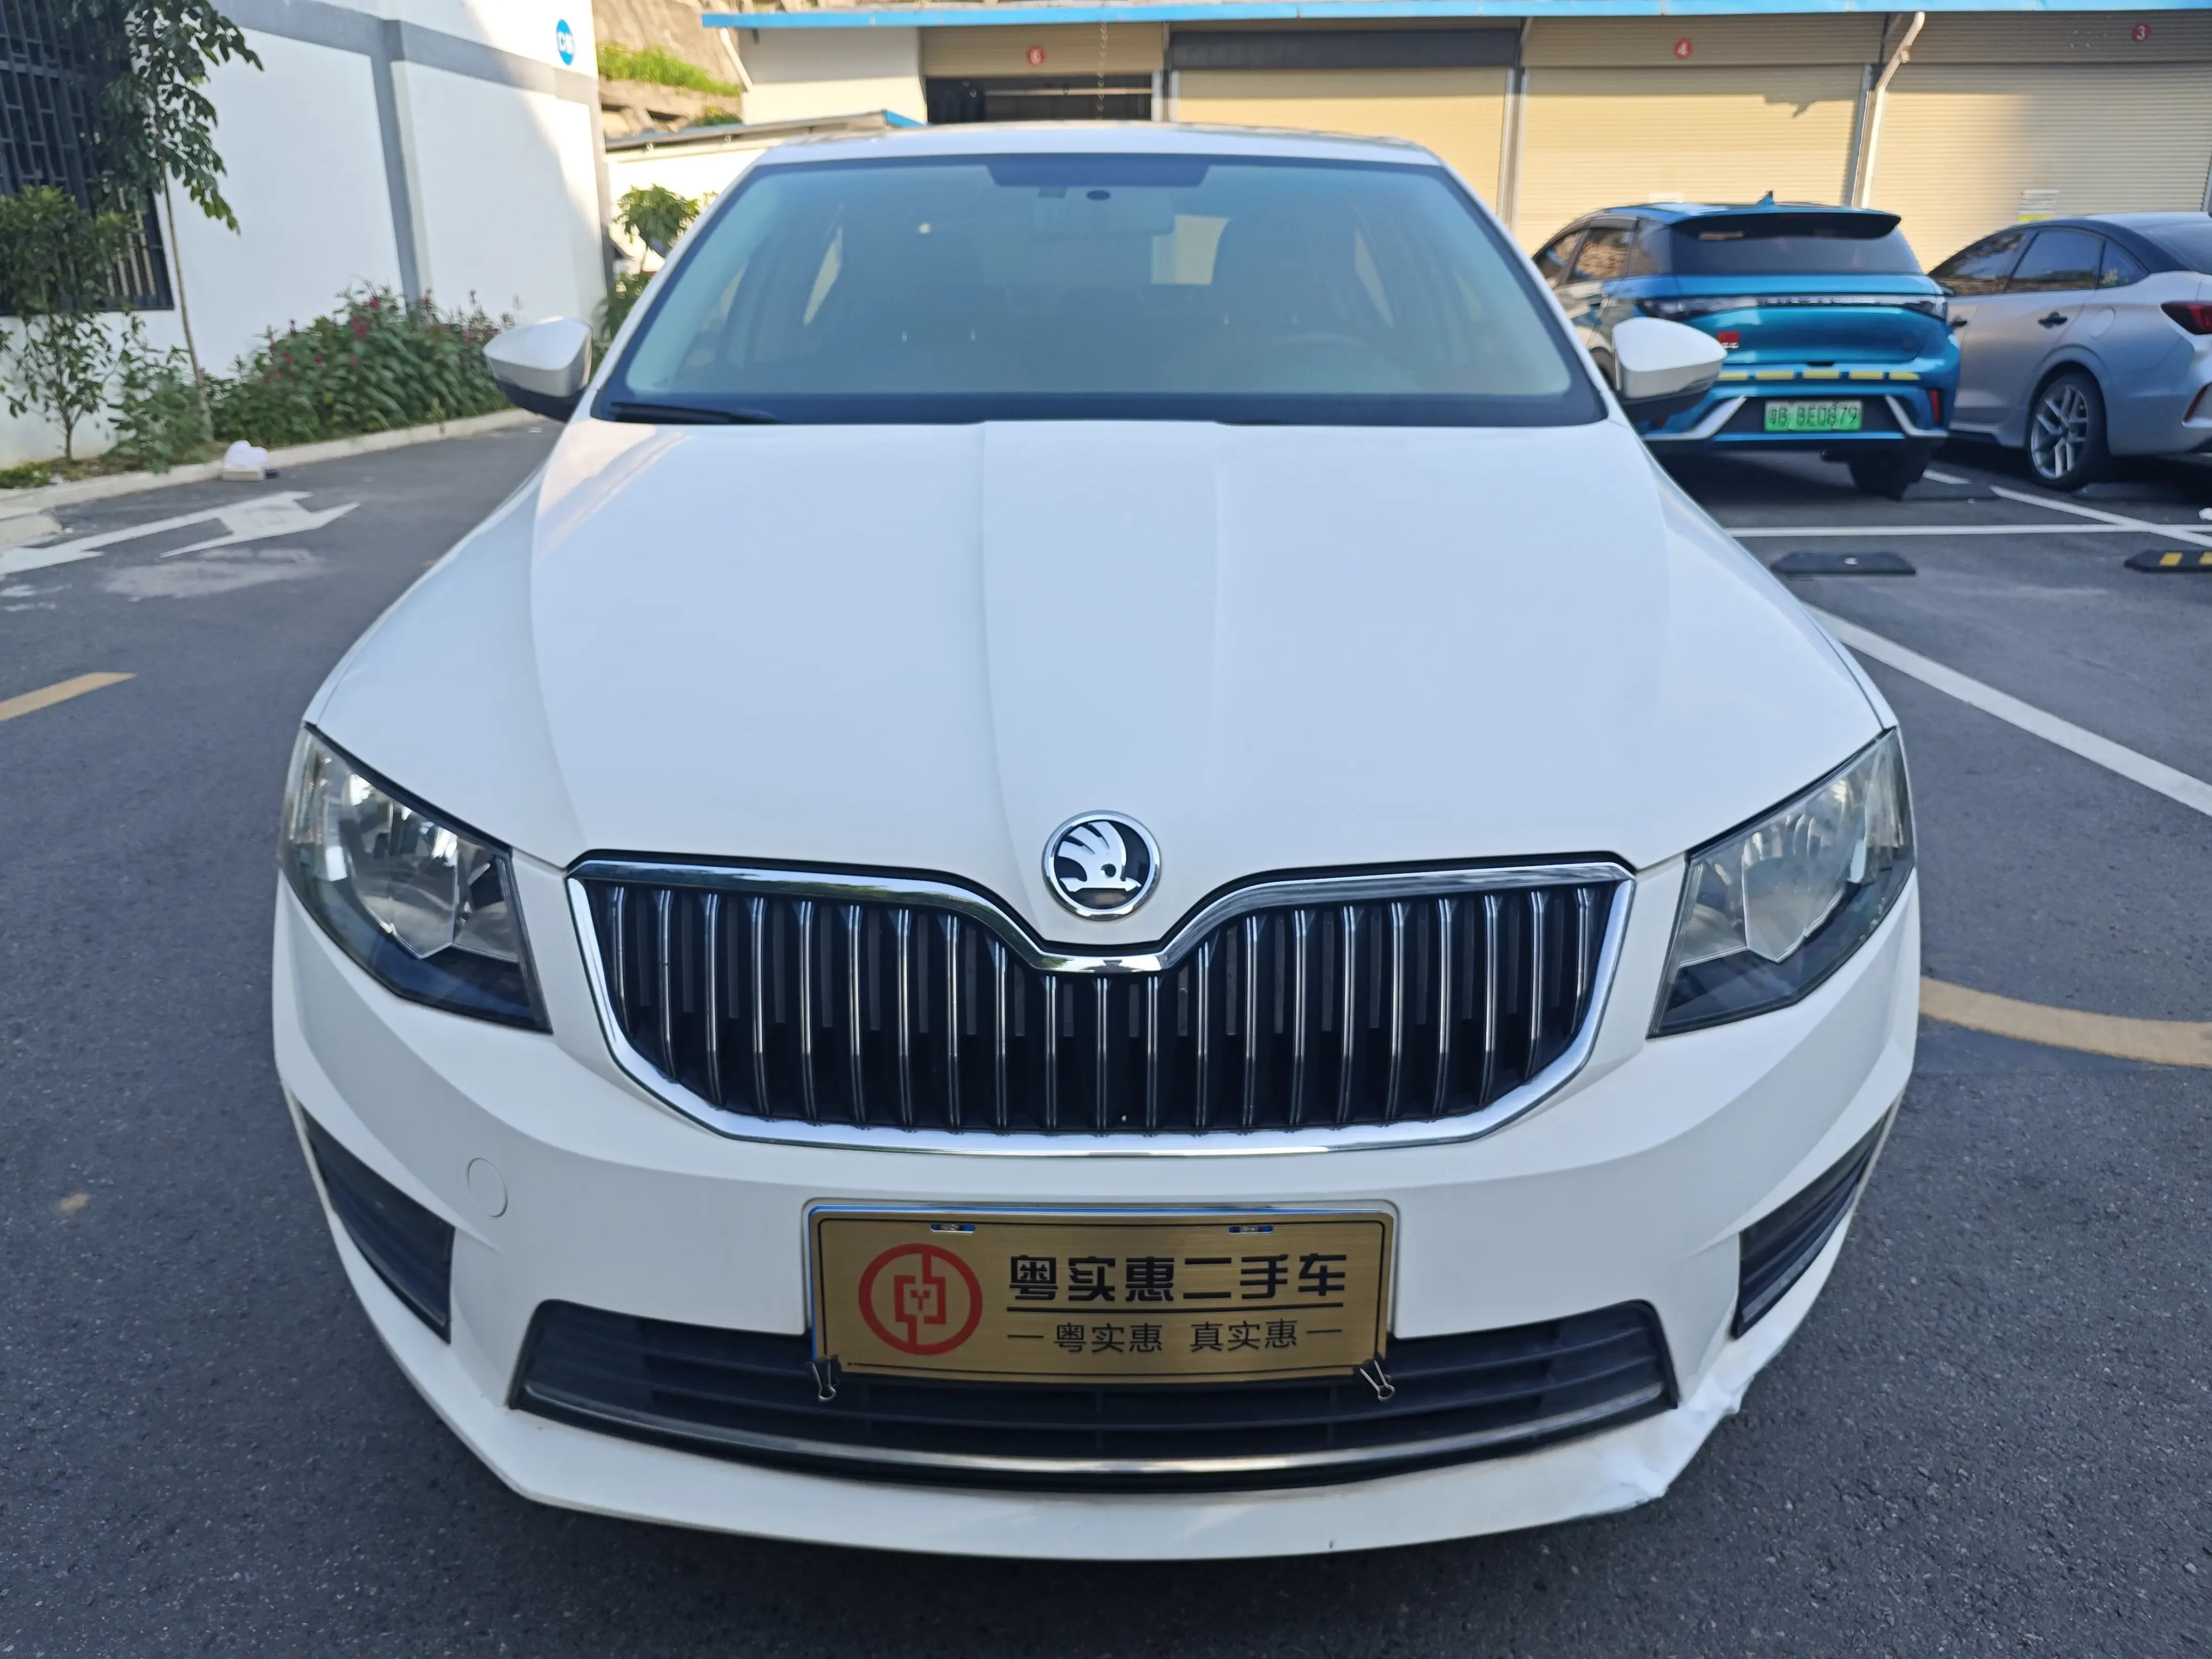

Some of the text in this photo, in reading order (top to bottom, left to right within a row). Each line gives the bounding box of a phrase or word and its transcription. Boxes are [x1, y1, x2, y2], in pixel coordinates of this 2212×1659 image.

[2136, 25, 2146, 41] 3
[1030, 49, 1042, 64] 6
[1677, 41, 1688, 56] 4
[1009, 1253, 1346, 1301] 粤实惠二手车
[1054, 1318, 1298, 1353] 粤实惠 真实惠
